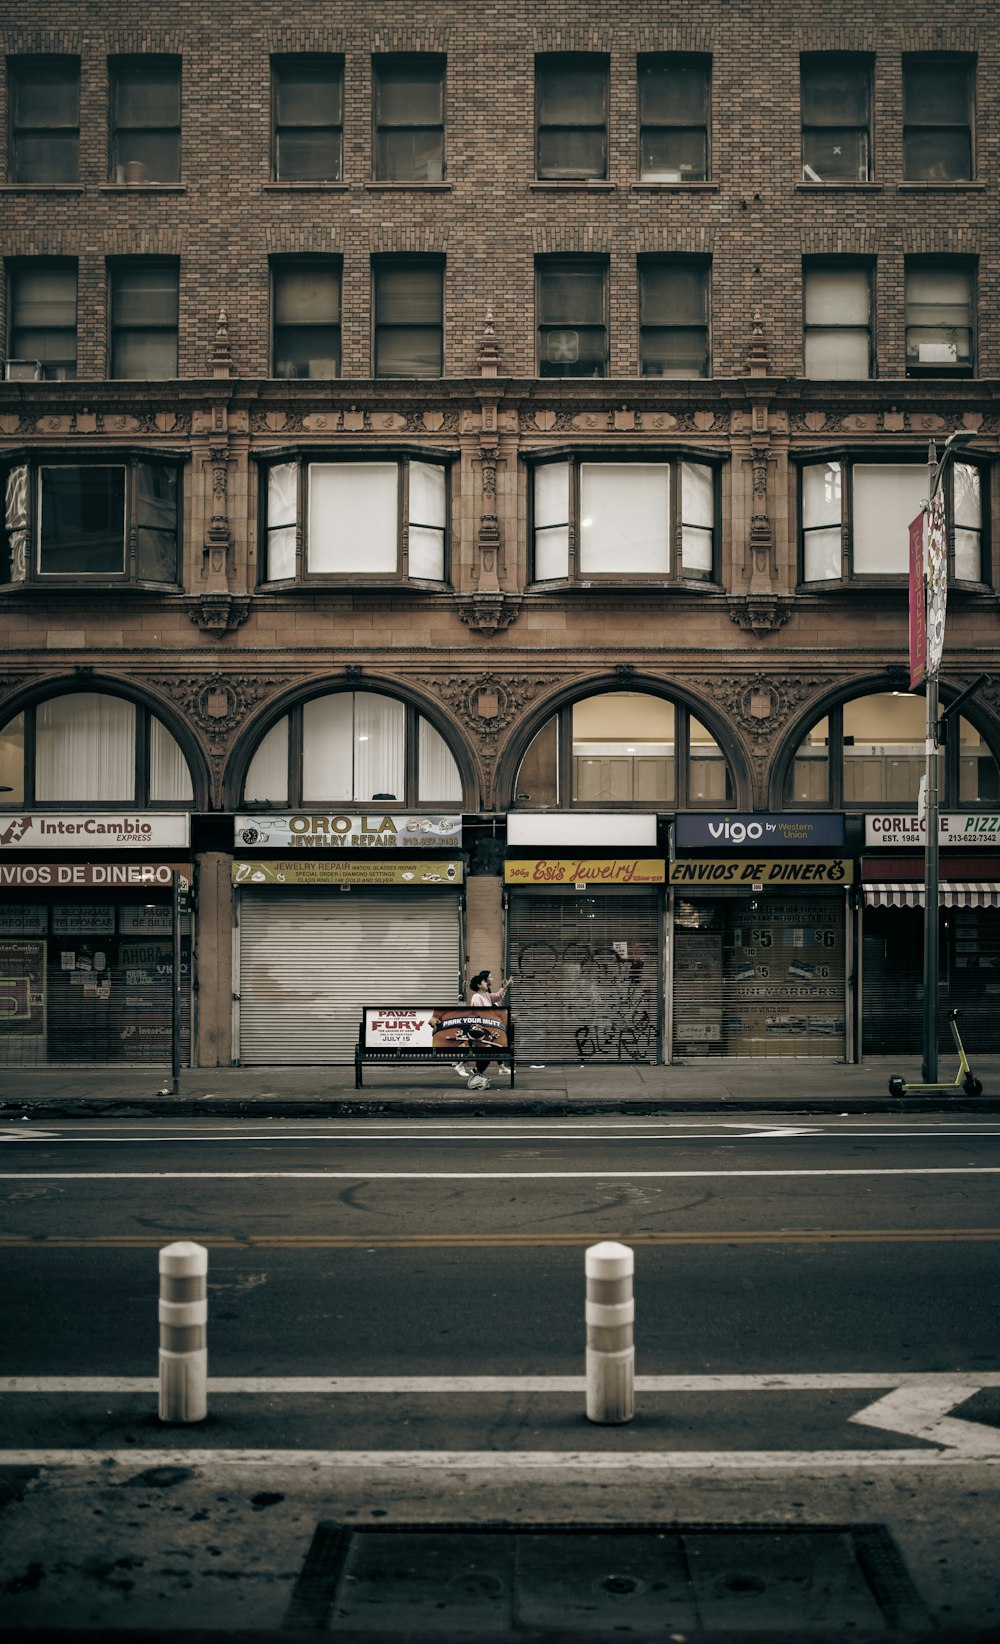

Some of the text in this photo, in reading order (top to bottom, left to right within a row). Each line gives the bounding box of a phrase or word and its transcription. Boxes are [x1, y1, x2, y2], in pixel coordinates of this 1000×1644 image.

[913, 532, 924, 657] murakami
[40, 819, 152, 834] InterCambio
[289, 816, 398, 833] ORO LA
[708, 817, 813, 843] vigo by Western
[288, 835, 347, 846] JEWELRY
[352, 835, 397, 846] REPAIR
[58, 867, 86, 883] DE
[92, 866, 172, 883] DINERO
[533, 860, 566, 881] Esi's
[570, 860, 639, 882] Jewelry
[671, 864, 740, 880] ENVIOS
[740, 864, 767, 880] DE
[0, 918, 41, 927] HEQUES
[779, 987, 838, 996] ORDERS
[371, 1021, 425, 1031] FURY
[443, 1018, 462, 1026] PARK
